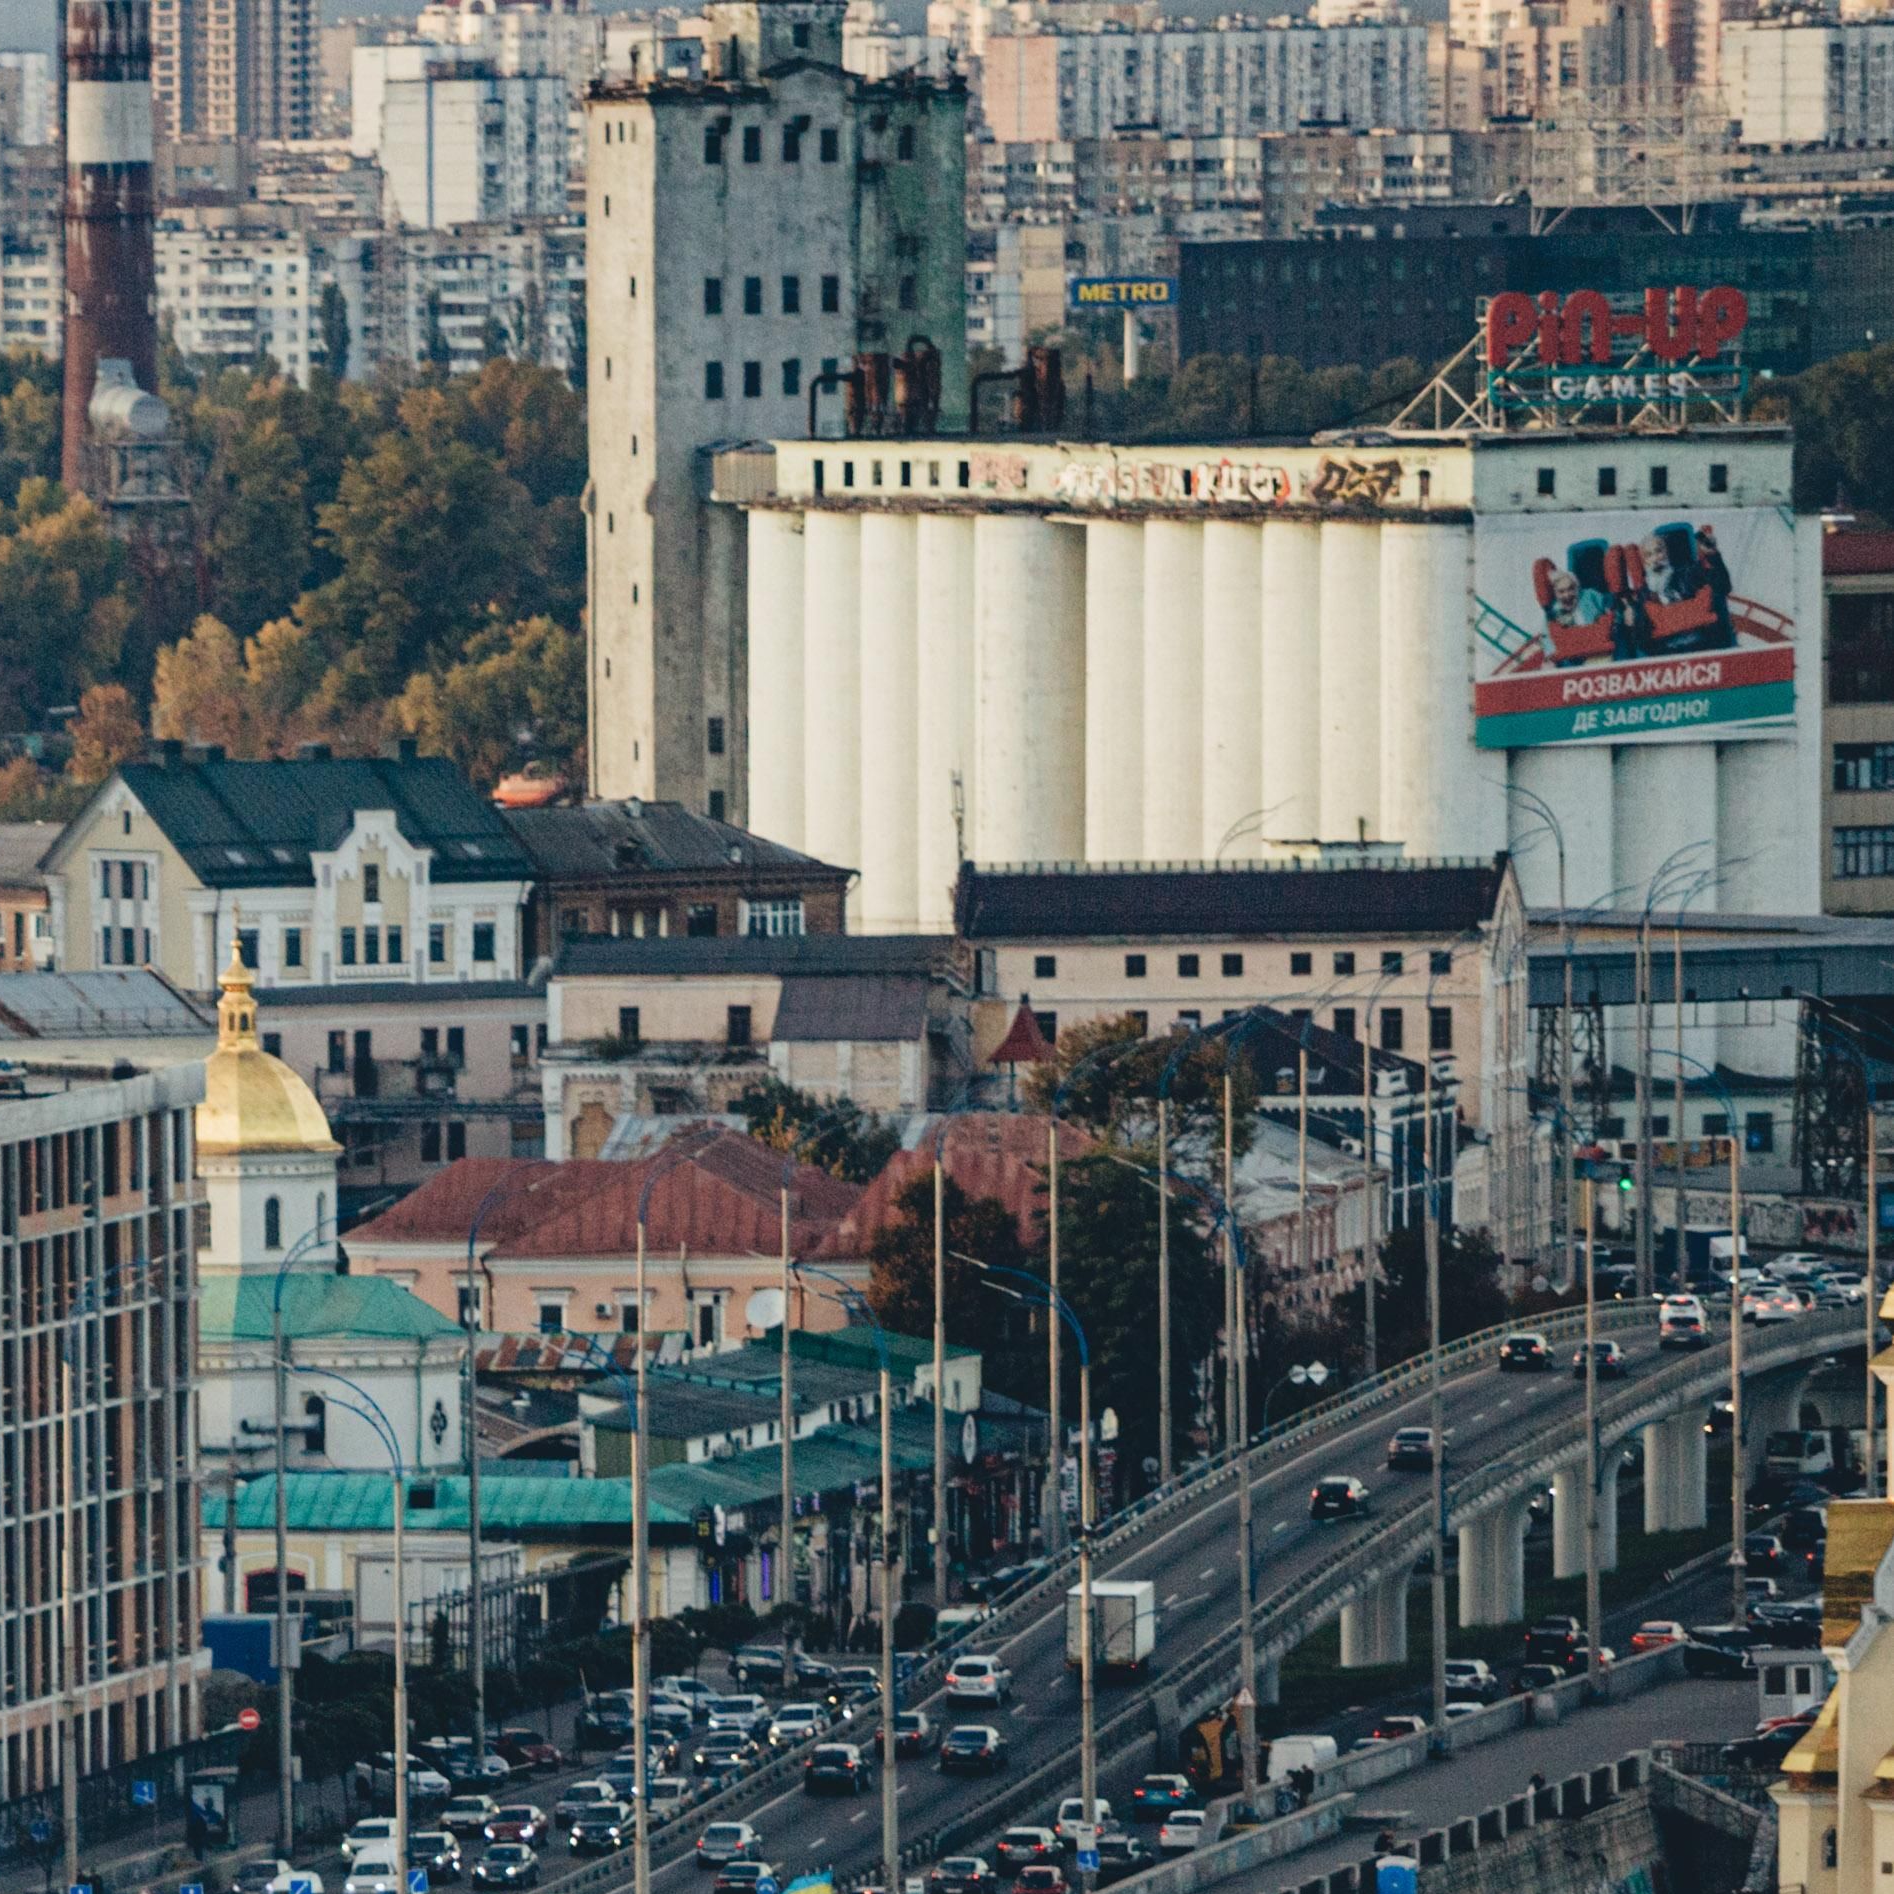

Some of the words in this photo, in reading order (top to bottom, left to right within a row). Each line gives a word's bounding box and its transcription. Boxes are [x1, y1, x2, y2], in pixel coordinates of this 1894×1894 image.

[1079, 282, 1169, 301] METRO
[1551, 374, 1687, 400] GAMES
[1562, 662, 1721, 701] РОЗВАЖАЙСЯ
[1572, 710, 1599, 734] ДЕ
[1603, 699, 1710, 727] ЗАВГОДНО!
